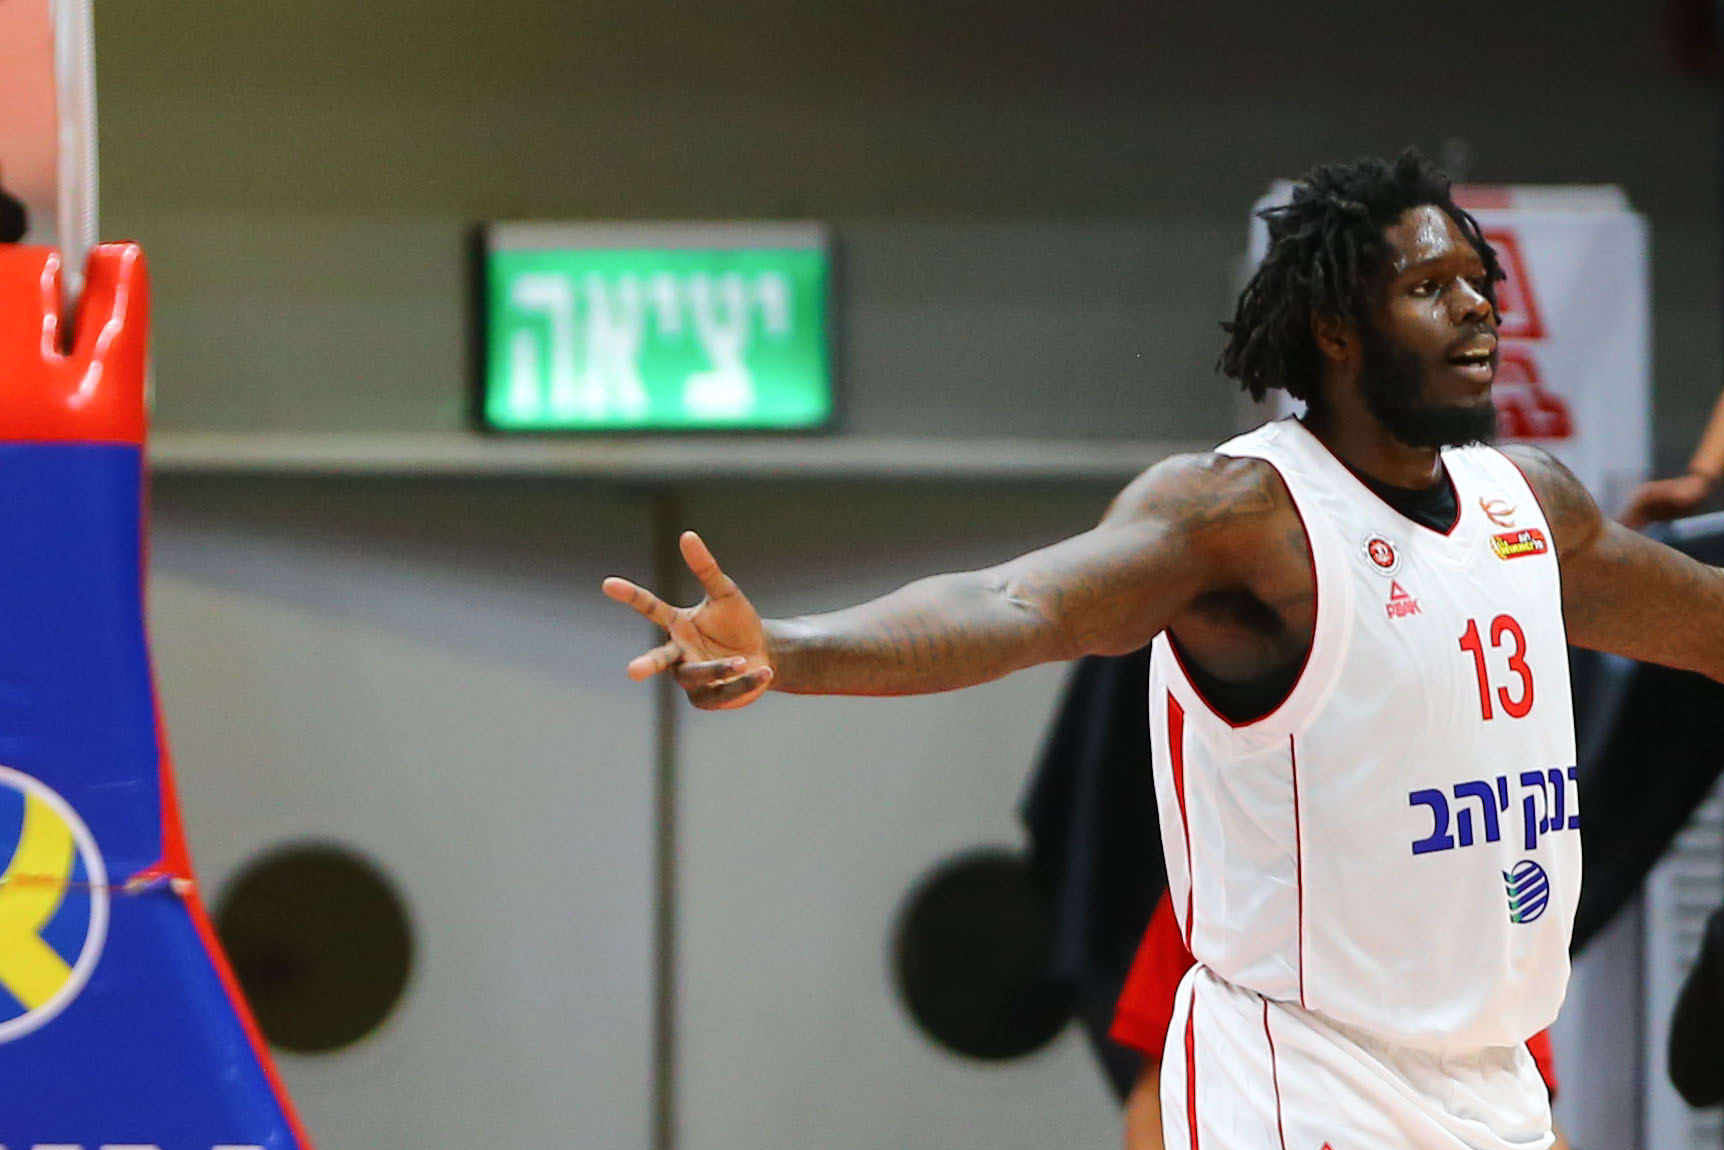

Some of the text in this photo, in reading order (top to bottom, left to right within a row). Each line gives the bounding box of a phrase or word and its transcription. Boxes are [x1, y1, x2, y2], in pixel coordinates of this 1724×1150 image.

[509, 271, 793, 421] יציאה
[1386, 600, 1422, 618] PEAK
[1459, 614, 1534, 720] 13
[1409, 775, 1509, 856] יהב
